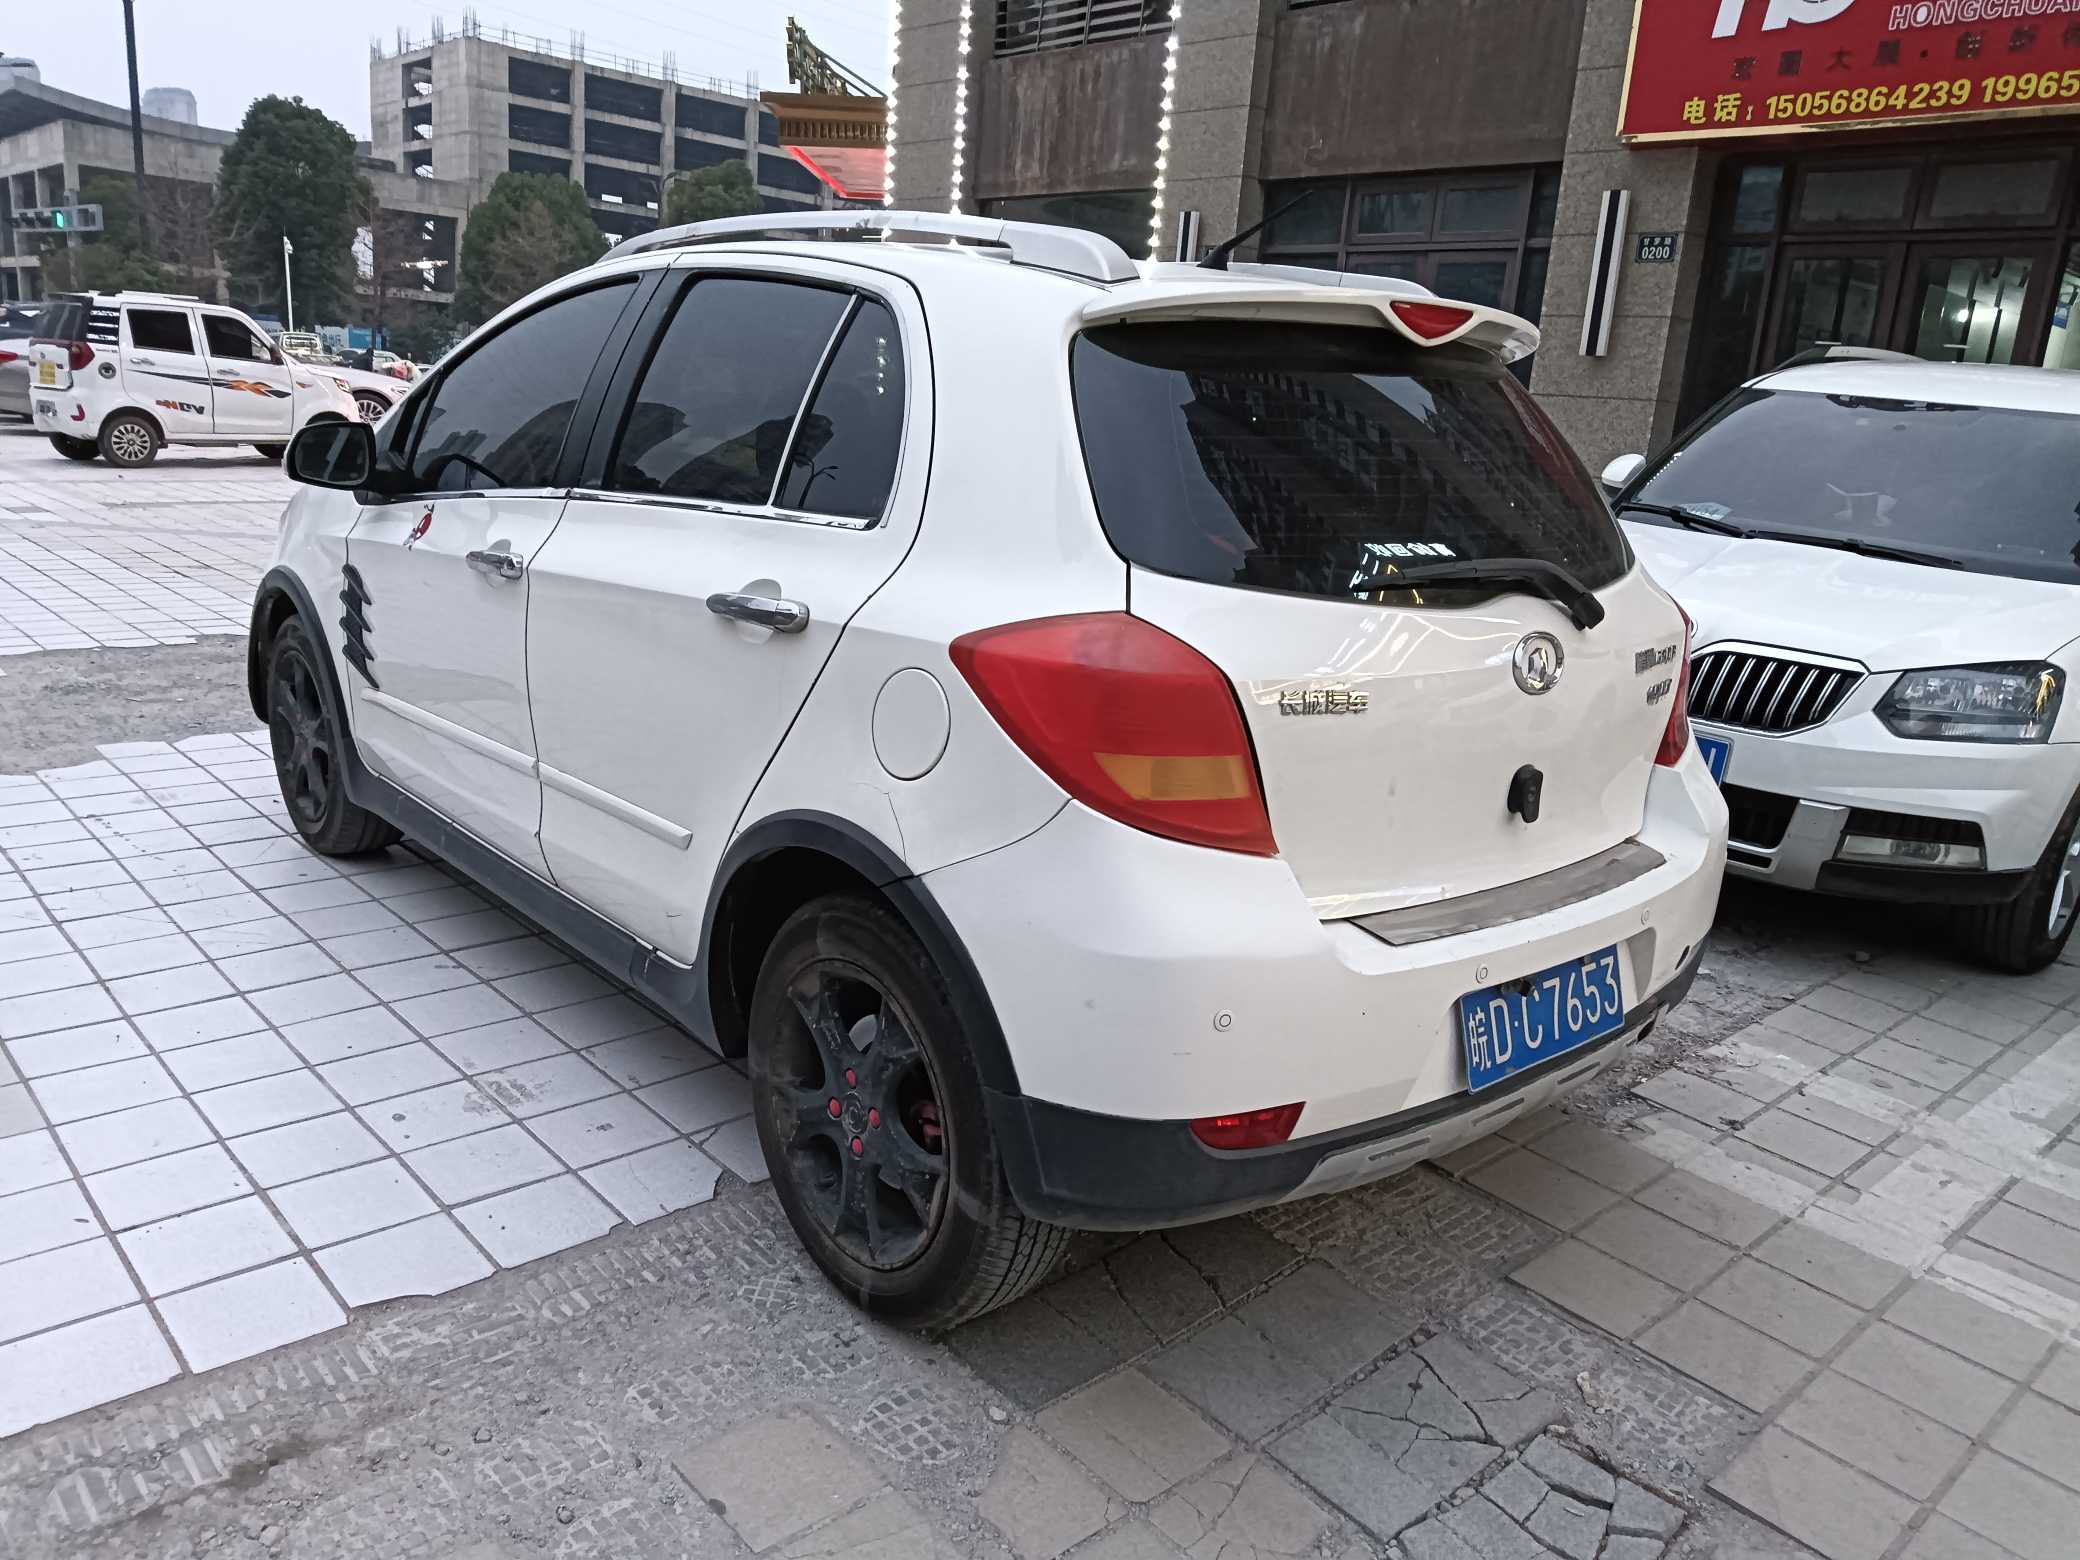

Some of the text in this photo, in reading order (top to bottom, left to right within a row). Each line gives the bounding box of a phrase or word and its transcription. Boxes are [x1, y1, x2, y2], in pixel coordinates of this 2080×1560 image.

[1888, 0, 2080, 31] HONGCHUA
[1766, 78, 1971, 120] 15056864239
[1981, 69, 2080, 104] 19965
[1641, 246, 1670, 260] 0200
